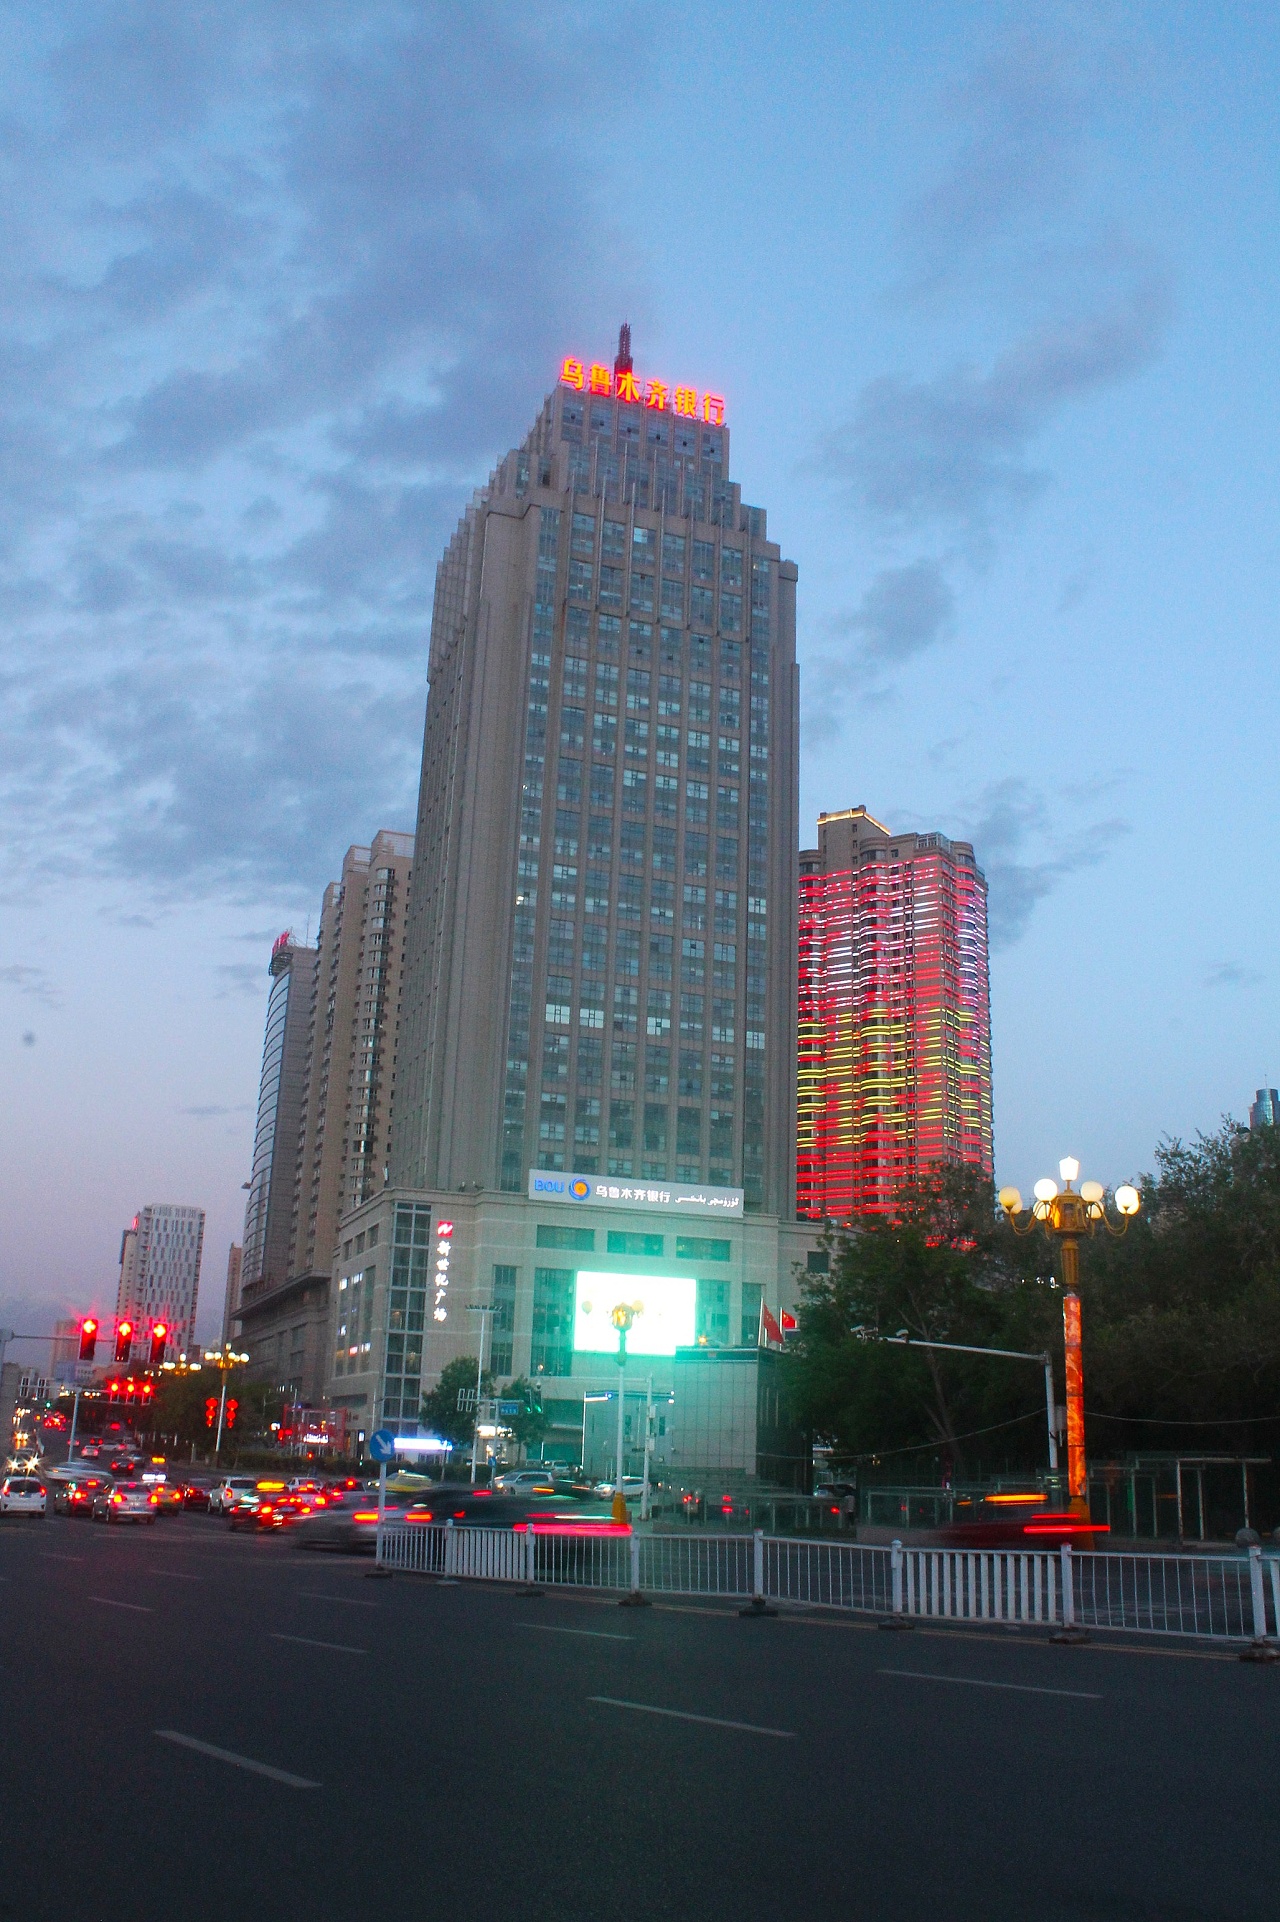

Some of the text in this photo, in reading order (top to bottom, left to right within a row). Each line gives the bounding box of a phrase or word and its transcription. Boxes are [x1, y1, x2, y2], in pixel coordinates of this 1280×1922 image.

[560, 357, 725, 426] 乌鲁木齐银行
[534, 1178, 565, 1193] BOU
[595, 1184, 671, 1204] 乌鲁木齐银行
[433, 1240, 452, 1323] 新世纪广场
